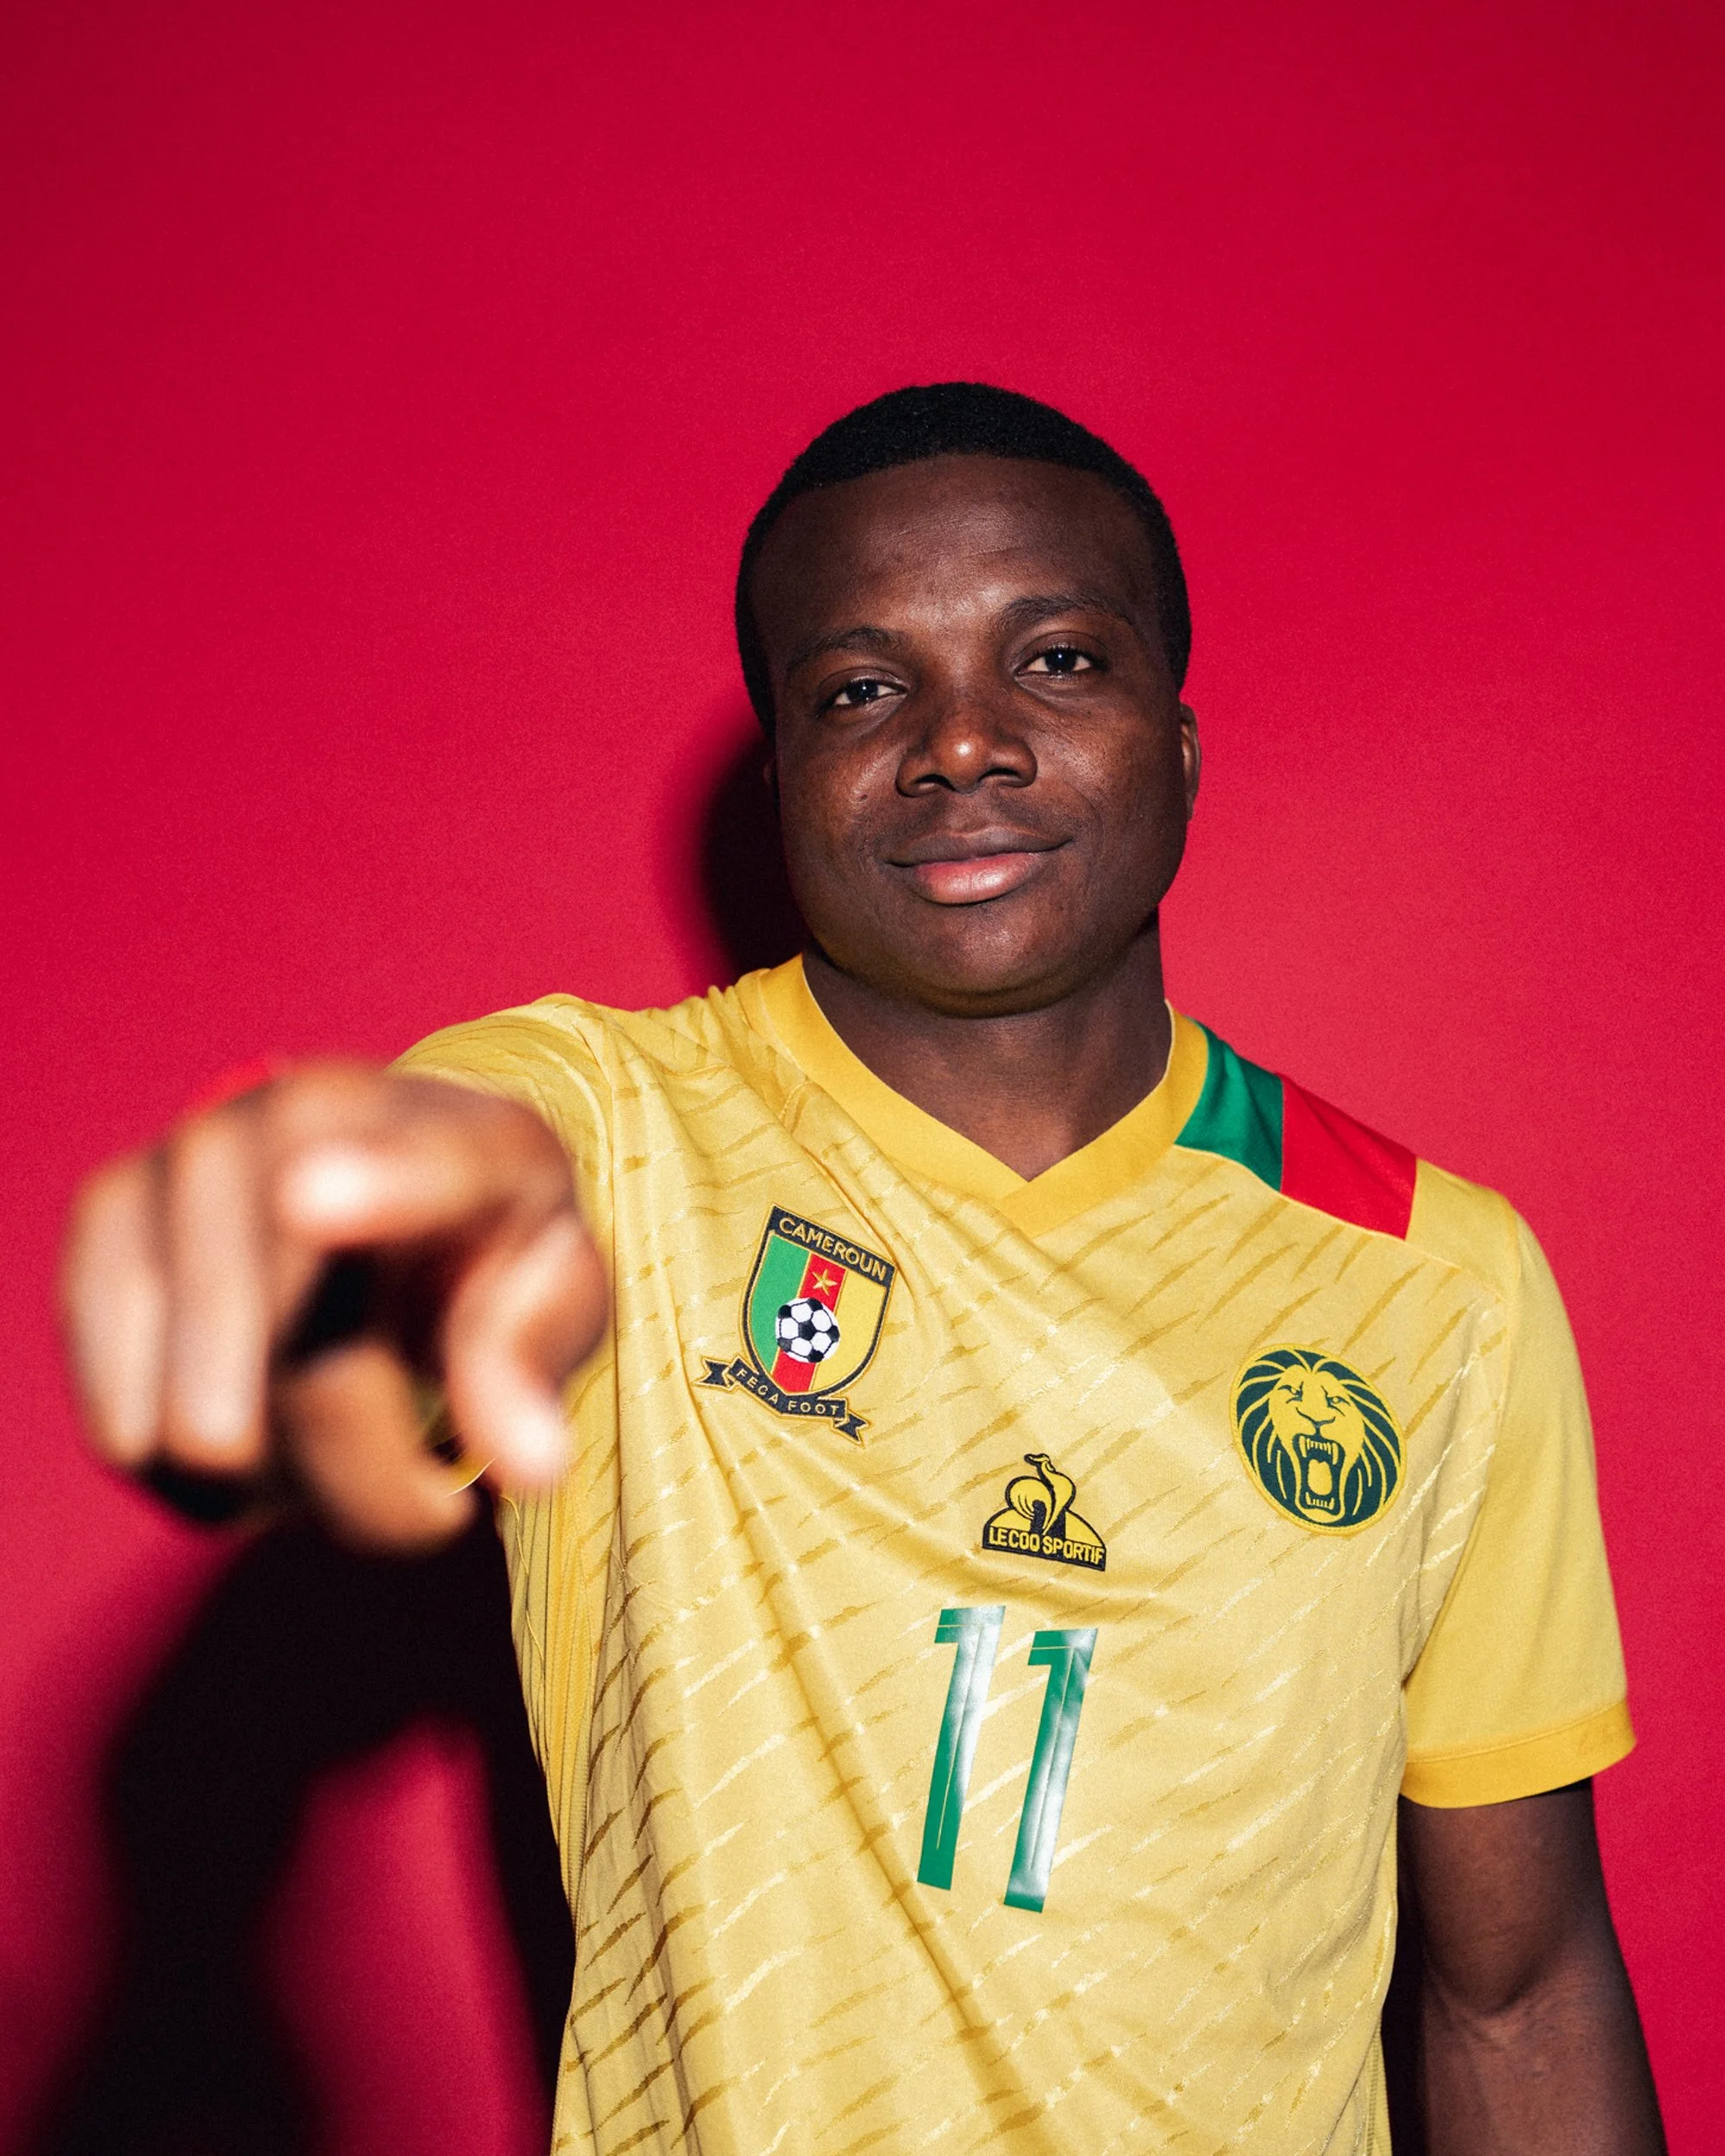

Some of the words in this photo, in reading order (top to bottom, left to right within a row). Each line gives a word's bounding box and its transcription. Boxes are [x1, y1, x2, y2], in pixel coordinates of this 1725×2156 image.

[779, 1217, 888, 1282] CAMEROUN
[736, 1369, 780, 1404] FECA
[787, 1400, 839, 1416] FOOT
[1042, 1535, 1103, 1565] SPORTIF
[917, 1605, 1098, 1913] 11
